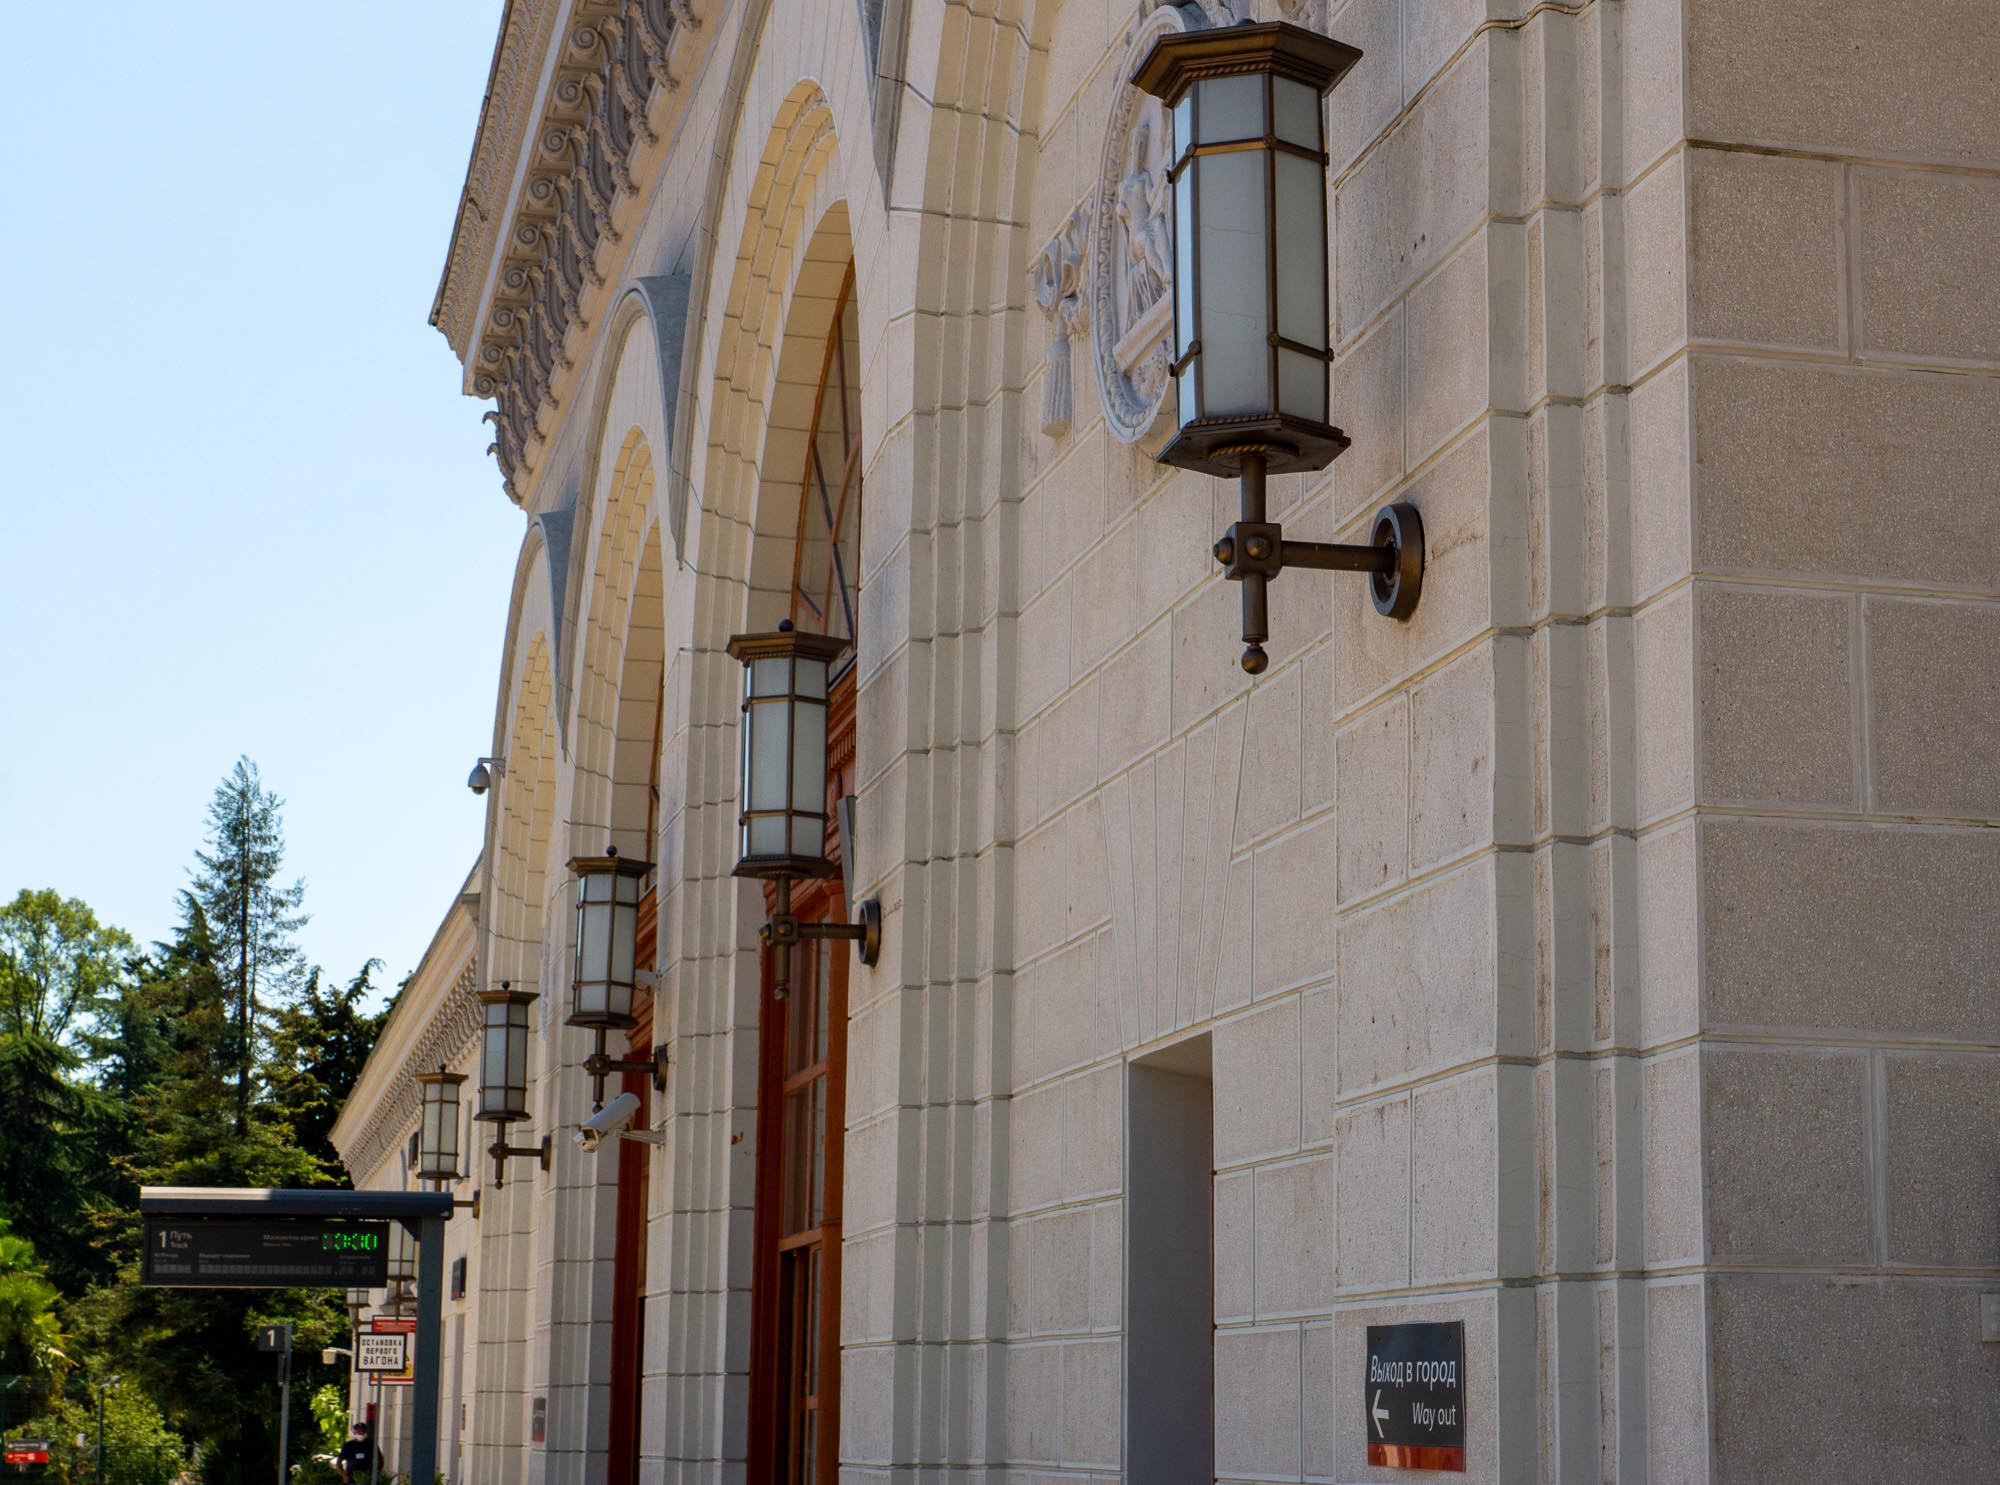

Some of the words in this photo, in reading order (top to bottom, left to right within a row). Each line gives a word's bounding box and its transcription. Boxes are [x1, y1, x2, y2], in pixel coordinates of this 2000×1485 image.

[160, 1231, 167, 1249] 1
[170, 1230, 193, 1241] Путь
[267, 1329, 275, 1347] 1
[361, 1338, 402, 1346] ОСТАНОВКА
[366, 1347, 398, 1355] ПЕРВОГО
[363, 1356, 399, 1366] ВАГОНА
[1370, 1355, 1404, 1388] Выход
[1406, 1361, 1413, 1383] в
[1416, 1361, 1456, 1392] город
[1412, 1402, 1436, 1431] Way
[1438, 1404, 1457, 1426] out
